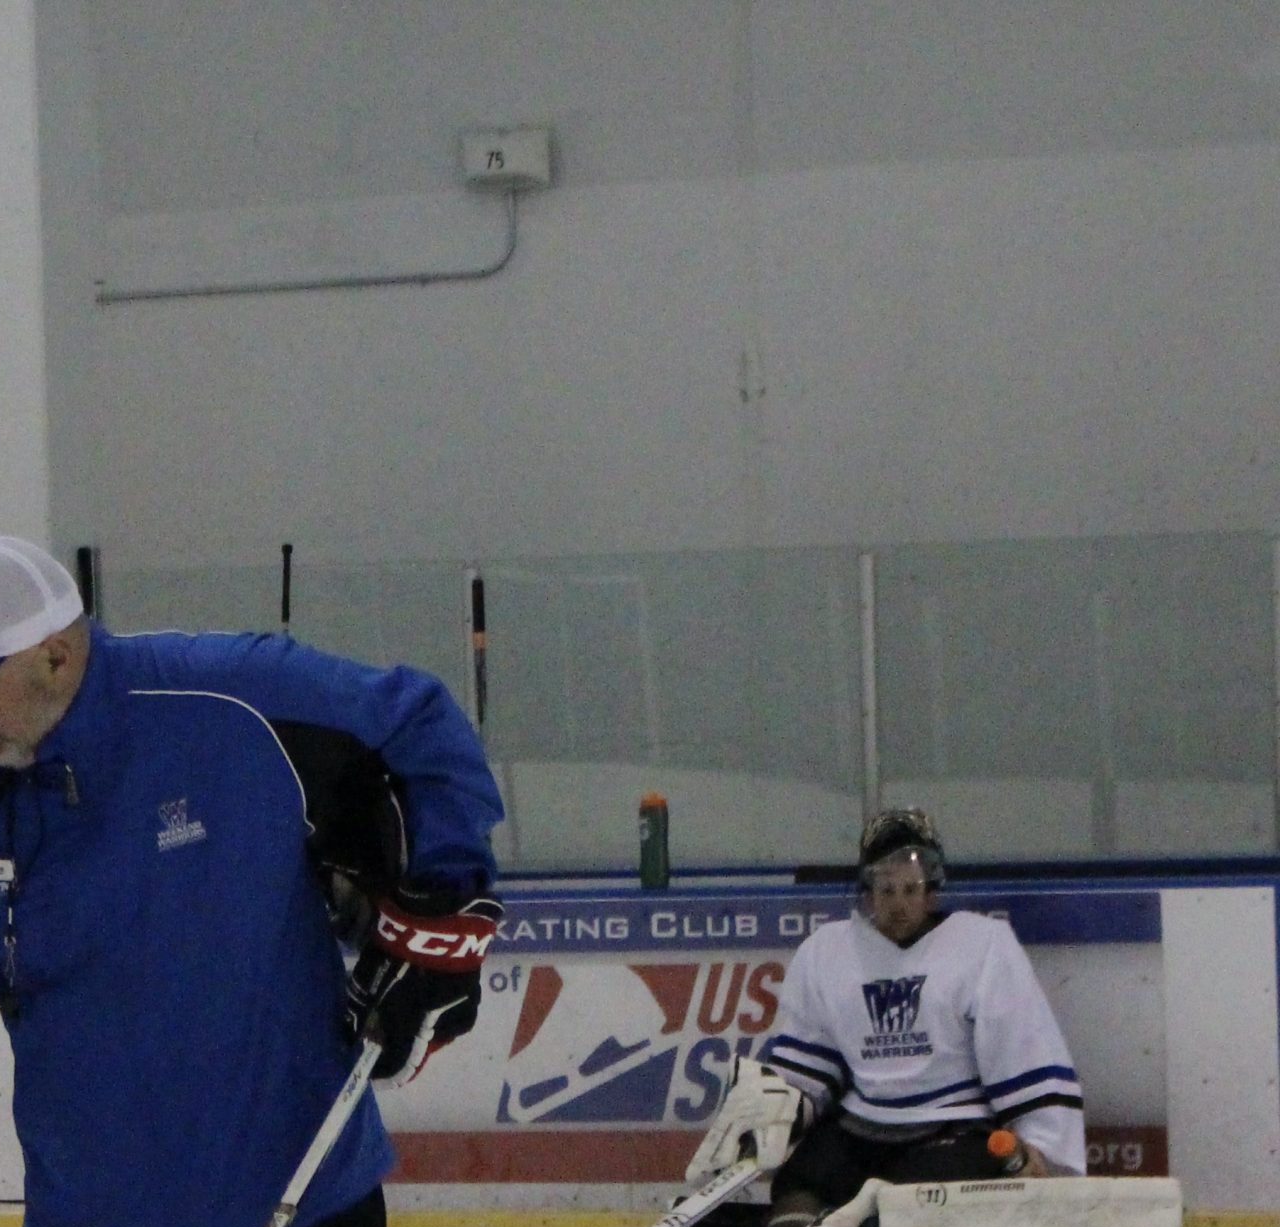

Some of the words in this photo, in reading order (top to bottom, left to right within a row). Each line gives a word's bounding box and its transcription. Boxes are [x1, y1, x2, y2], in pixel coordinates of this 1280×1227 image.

[486, 151, 504, 169] 75
[376, 910, 493, 958] CCM
[489, 966, 524, 993] of
[863, 1031, 929, 1047] WEEKEND
[859, 1044, 933, 1060] WARRIORS
